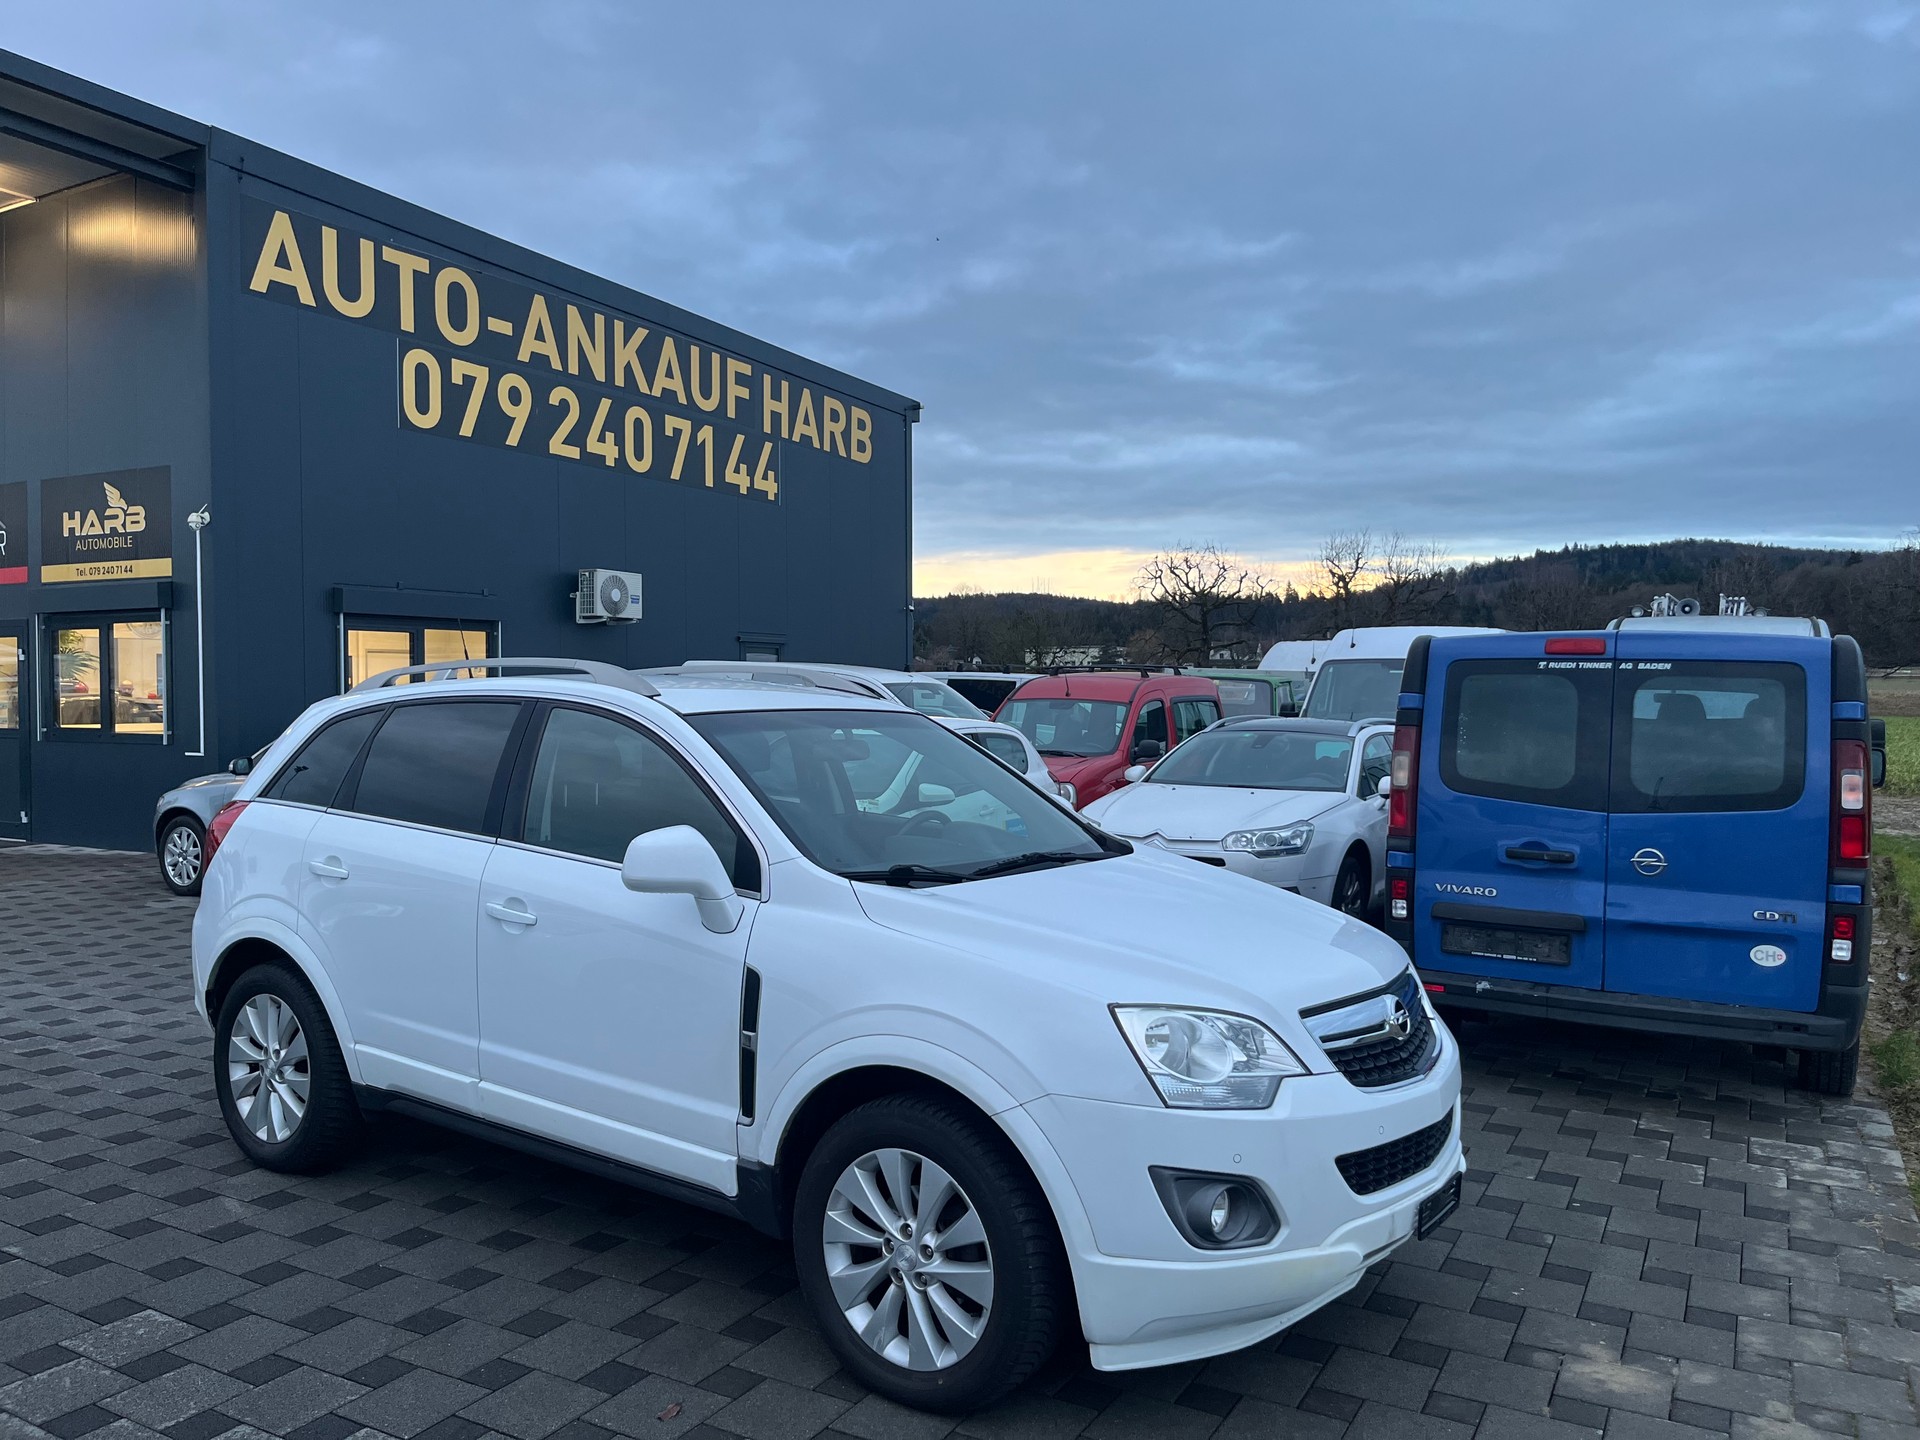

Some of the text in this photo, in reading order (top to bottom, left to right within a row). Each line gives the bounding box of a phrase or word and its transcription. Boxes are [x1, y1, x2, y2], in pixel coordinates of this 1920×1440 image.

[250, 211, 873, 463] AUTO-ANKAUF HARB
[402, 348, 532, 446] 079
[548, 386, 653, 473] 240
[63, 505, 146, 537] HARB
[75, 536, 133, 551] AUTOMOBILE
[75, 567, 88, 577] Tel.
[88, 566, 101, 576] 079
[102, 565, 115, 575] 240
[1548, 661, 1576, 669] RUEDI
[1435, 883, 1497, 897] VIVARO
[1754, 949, 1777, 962] CH
